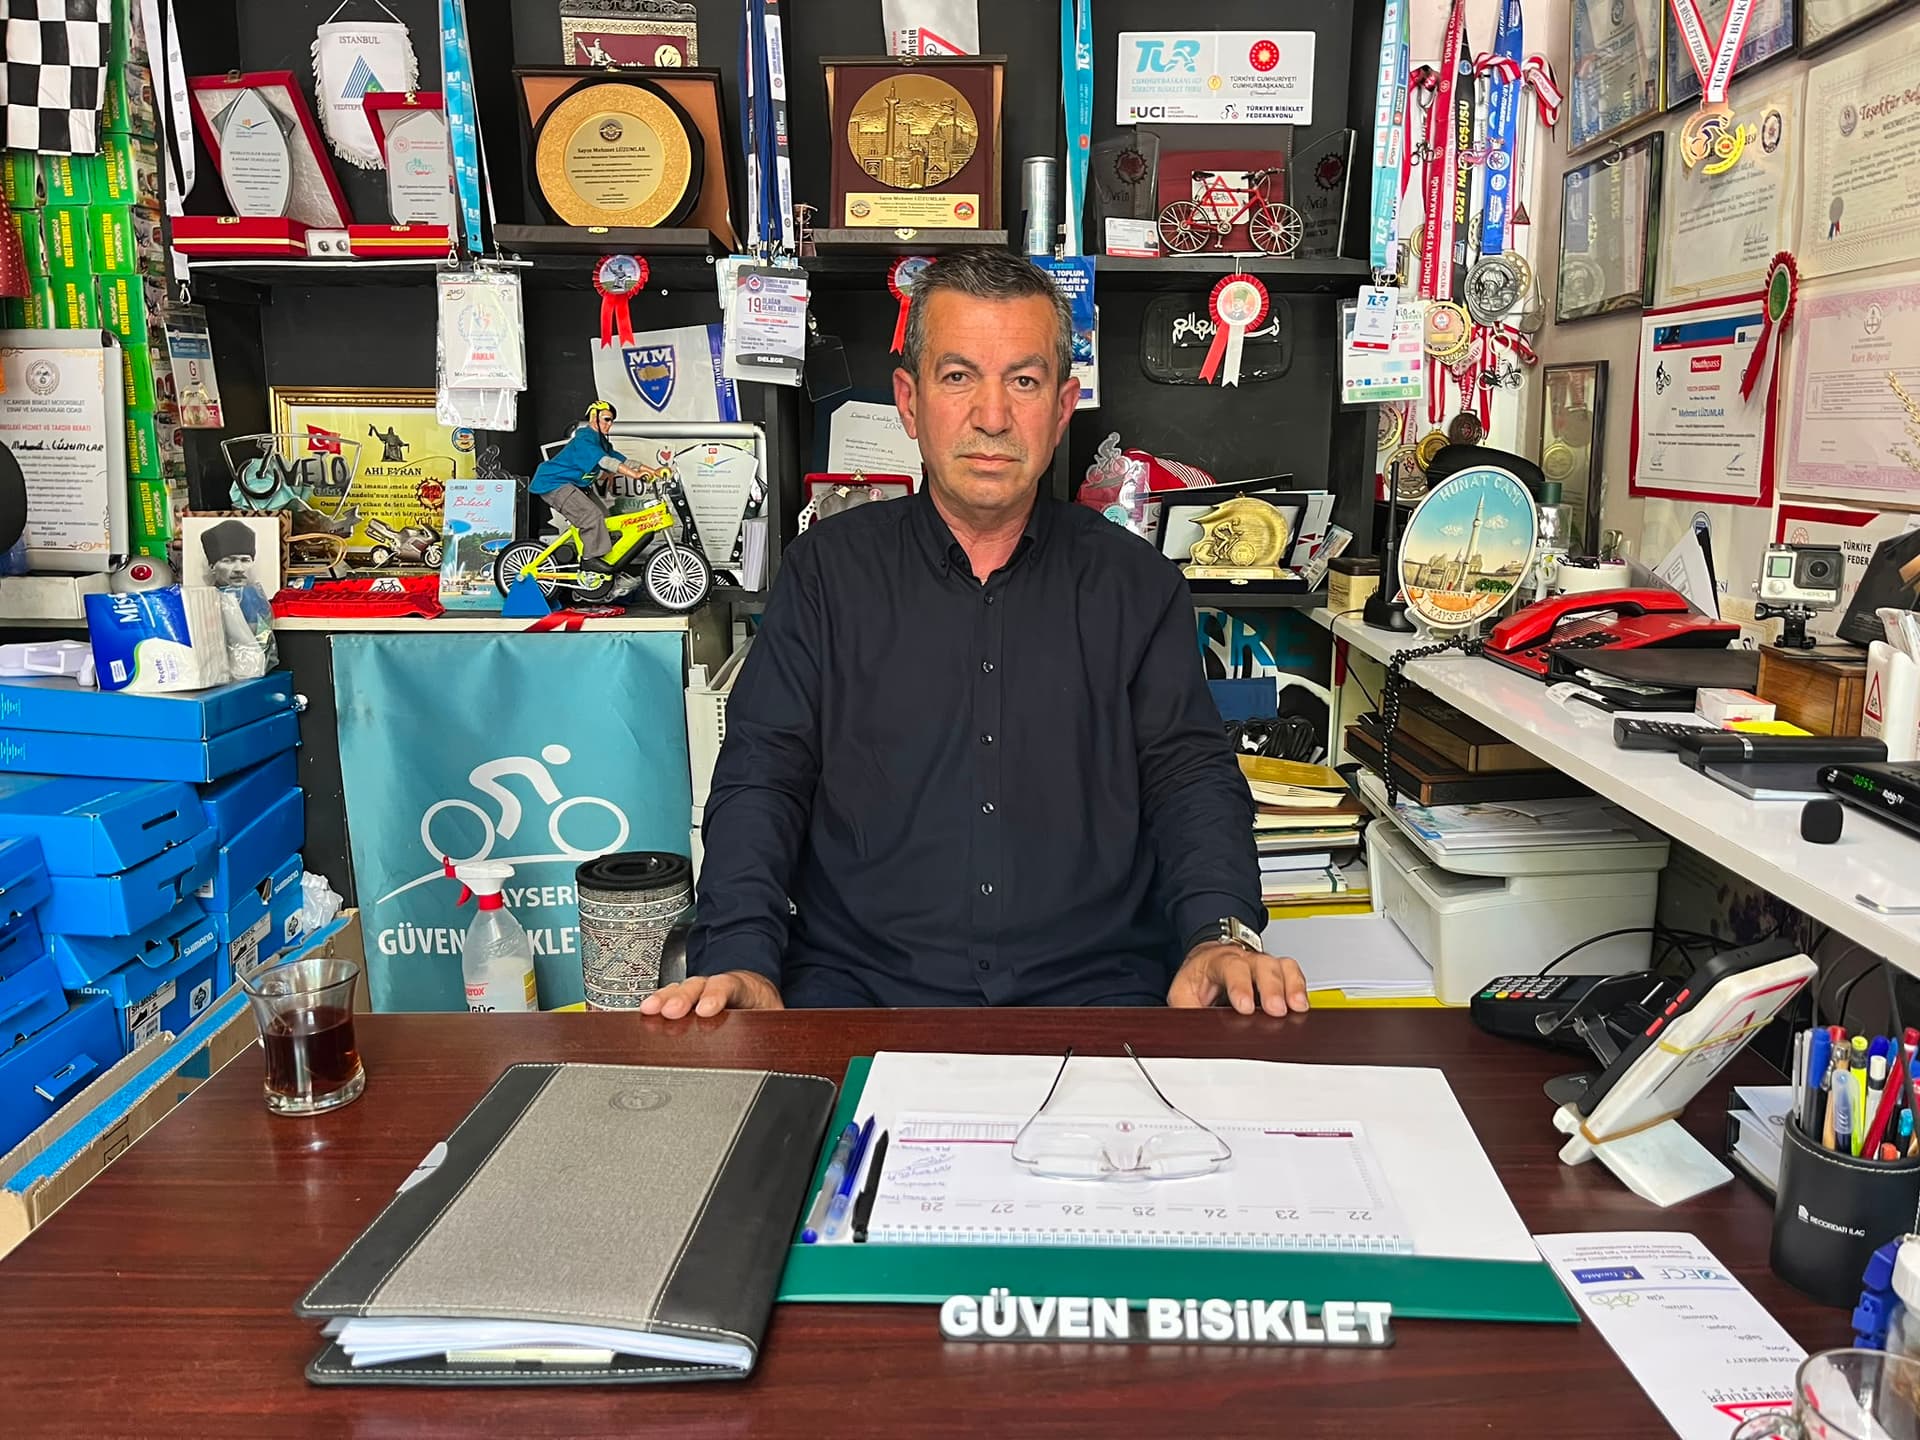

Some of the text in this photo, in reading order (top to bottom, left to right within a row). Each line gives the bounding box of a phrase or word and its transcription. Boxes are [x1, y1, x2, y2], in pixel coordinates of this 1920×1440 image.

[1135, 40, 1201, 73] TUR
[1137, 106, 1166, 119] UCI
[1275, 105, 1305, 113] BİSİKLET
[1458, 100, 1470, 150] KOŞUSU
[1429, 176, 1439, 218] BAKANLIĞI
[1455, 191, 1467, 224] 2021
[1427, 219, 1435, 238] SPOR
[1426, 239, 1434, 252] VE
[1423, 254, 1433, 283] GENÇLİK
[1439, 474, 1490, 503] HUNAT
[1843, 540, 1872, 553] TÜRKİYE
[274, 870, 299, 894] SHIMANO
[500, 880, 580, 908] AYSERİ
[183, 932, 214, 957] SHIMANO
[378, 920, 465, 955] GÜVEN
[920, 1202, 944, 1212] 28
[991, 1203, 1014, 1213] 27
[1062, 1205, 1085, 1215] 26
[1133, 1206, 1155, 1216] 25
[1204, 1208, 1228, 1218] 24
[1276, 1209, 1300, 1220] 23
[1350, 1211, 1373, 1220] 22
[1810, 1215, 1847, 1234] RECORDATI
[1661, 1268, 1698, 1280] ECF
[940, 1287, 1130, 1339] GÜVEN
